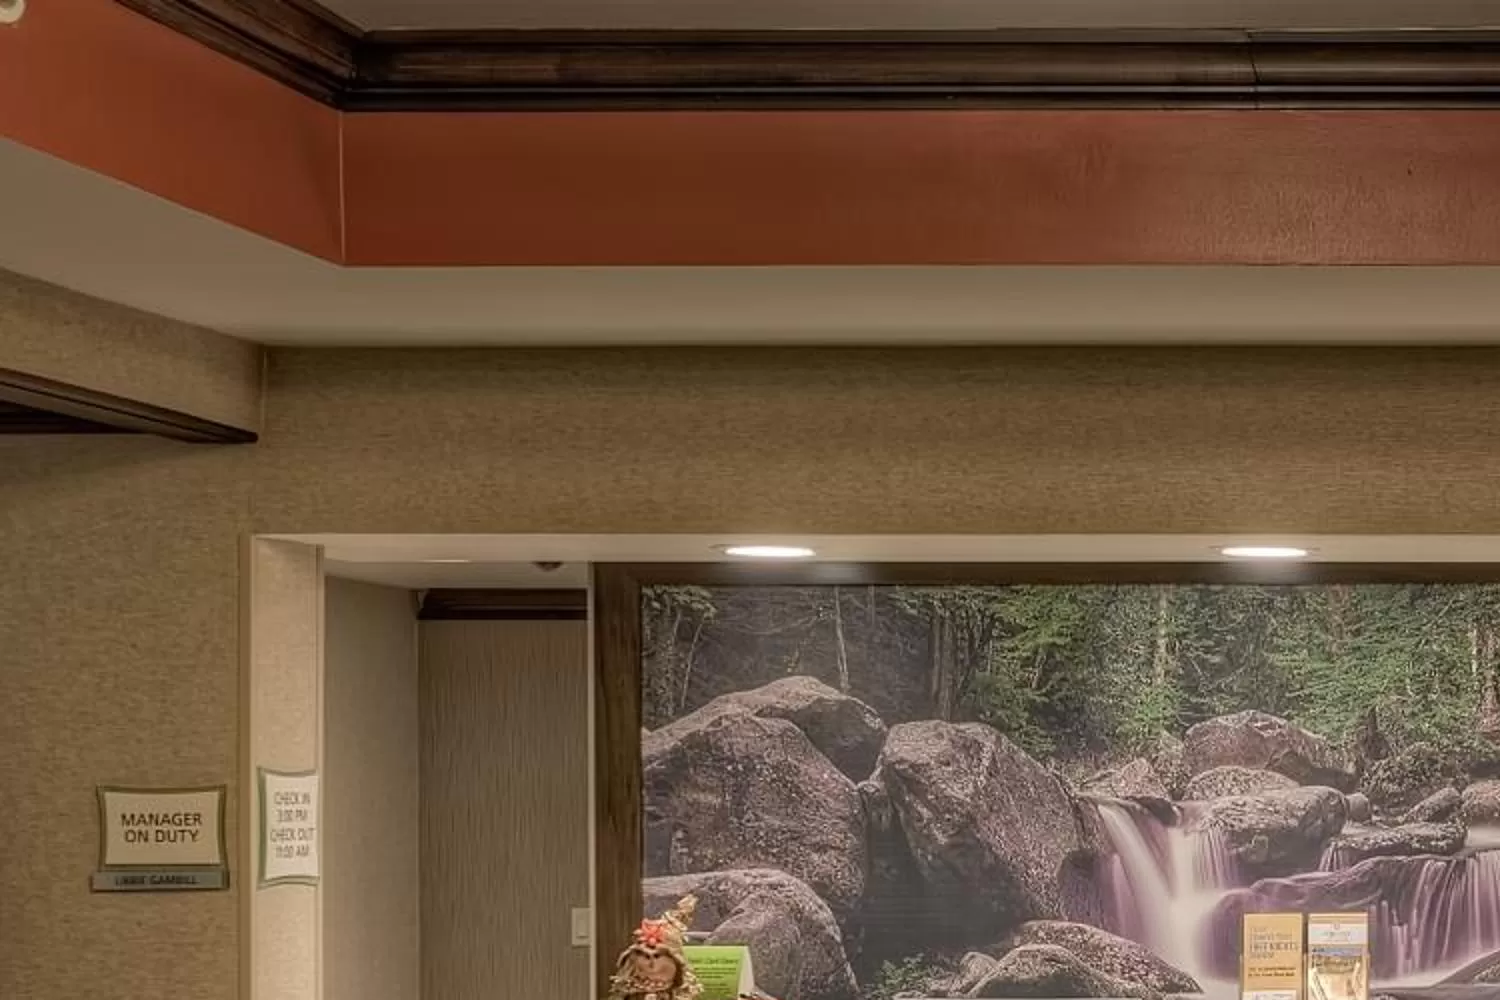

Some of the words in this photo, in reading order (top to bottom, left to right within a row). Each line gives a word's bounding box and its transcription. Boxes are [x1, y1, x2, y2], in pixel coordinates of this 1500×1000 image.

[121, 812, 203, 827] MANAGER
[125, 828, 149, 843] ON
[155, 828, 199, 843] DUTY
